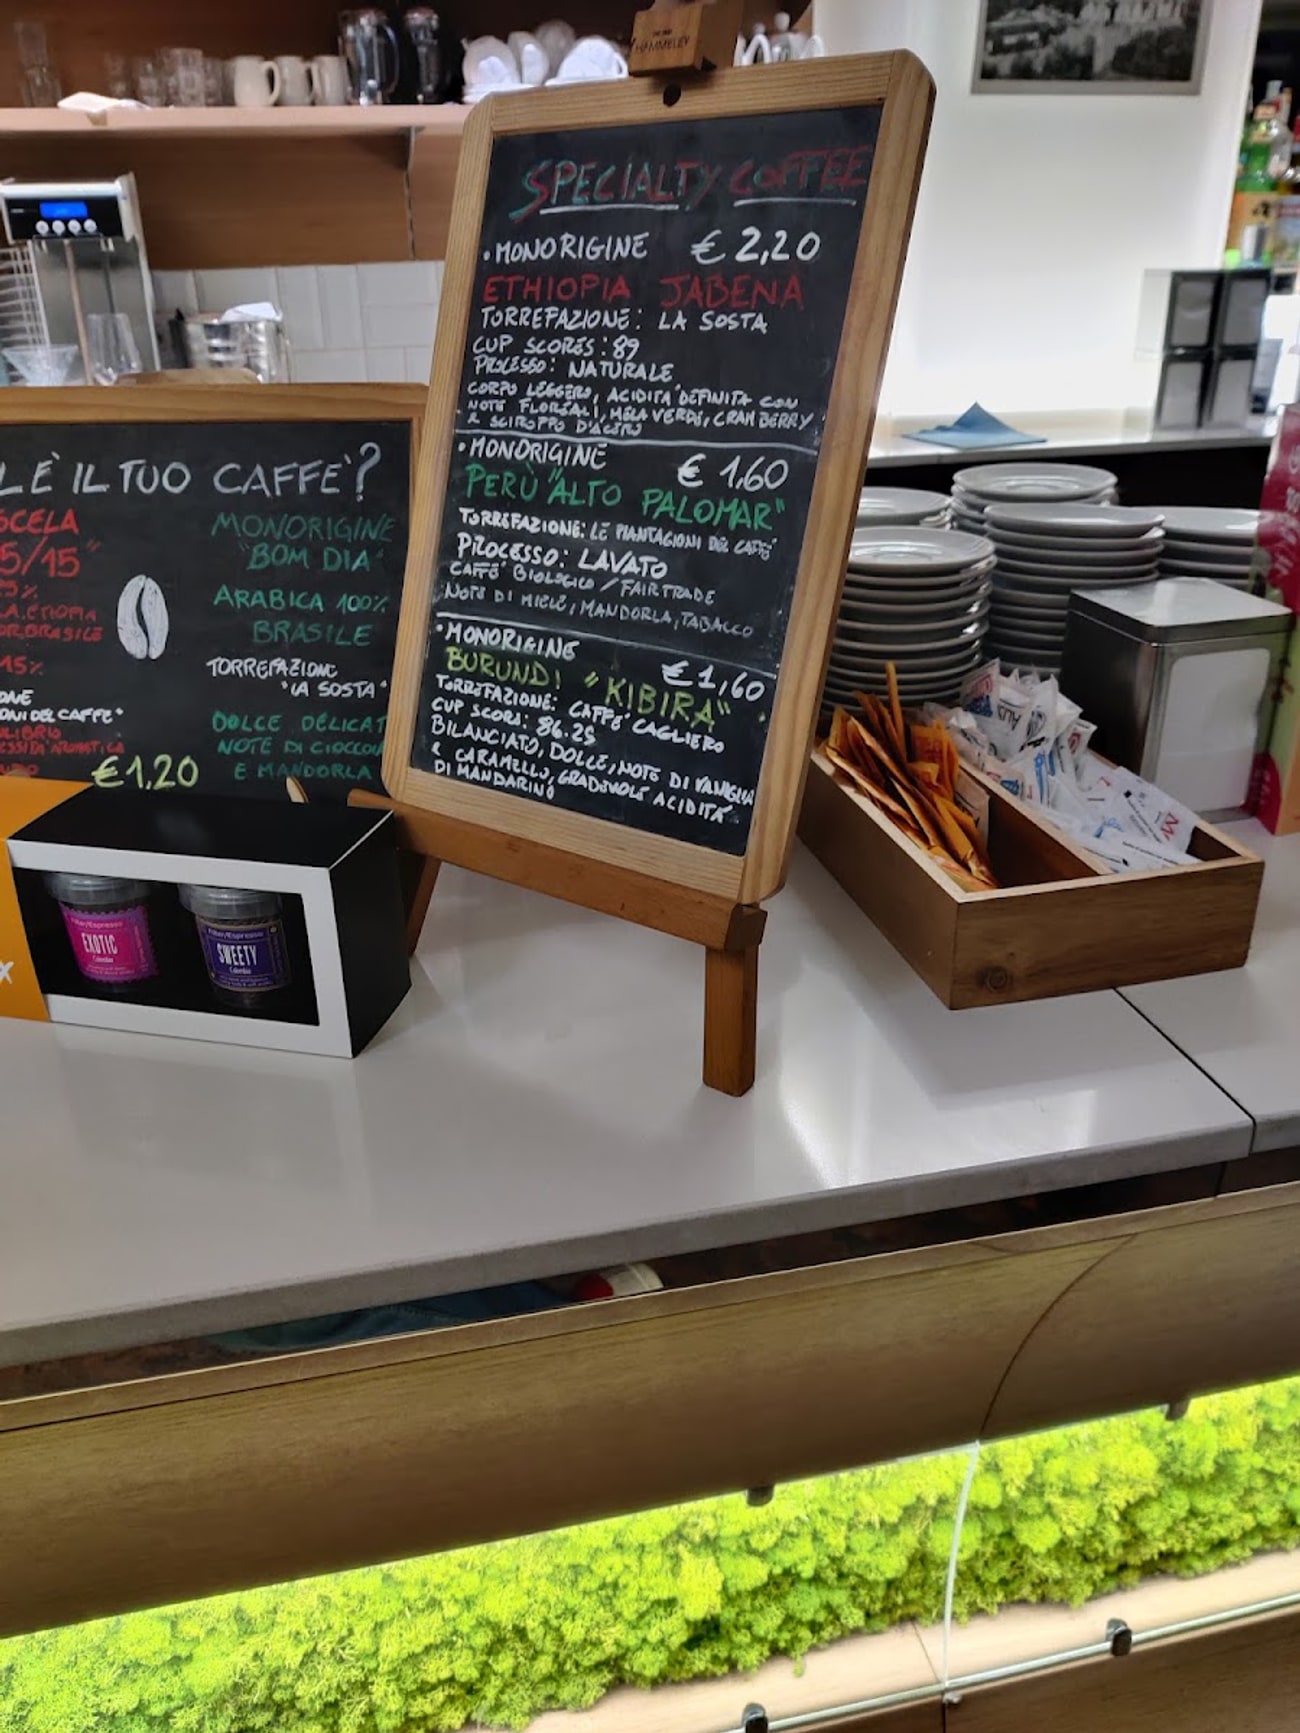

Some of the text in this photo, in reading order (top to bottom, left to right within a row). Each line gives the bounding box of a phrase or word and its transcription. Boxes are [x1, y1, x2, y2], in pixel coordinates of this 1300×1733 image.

[508, 145, 869, 223] SPECIALTY COFFEE
[735, 226, 821, 268] 2,20
[482, 274, 805, 311] ETHIOPIA JABENA
[481, 306, 767, 334] TORREFAZIONE: LA SOSTA
[472, 335, 514, 356] CUP
[568, 361, 674, 383] NATURALE
[467, 381, 518, 396] CORPO
[759, 396, 799, 410] CON
[467, 400, 506, 412] NOTE
[610, 406, 648, 422] MELA
[490, 416, 565, 432] SCIROPPO
[72, 462, 109, 494] IL
[119, 458, 191, 495] TUO
[470, 436, 607, 469] MONORIGINE
[719, 456, 790, 491] 1,60
[210, 512, 398, 544] MONORIGINE
[590, 522, 611, 541] LE
[616, 523, 702, 550] PIANTAGIONI
[708, 536, 729, 552] DEL
[513, 564, 594, 590] BIOLOGICO
[578, 548, 668, 579] LAVATO
[213, 584, 389, 614] ARABICA 100%
[445, 583, 486, 600] NOTE
[494, 590, 512, 603] DI
[681, 612, 754, 638] TABACCO
[252, 620, 374, 646] BRASILE
[445, 622, 581, 660] MONORIGINE
[206, 656, 338, 679] TORREFAZIONE
[30, 709, 56, 723] DEL
[431, 697, 464, 714] CUP
[536, 715, 596, 746] 86.25
[218, 737, 272, 755] NOTE
[284, 741, 303, 754] DI
[632, 718, 724, 753] CAGLIERO
[235, 762, 372, 780] E MANDORLA
[434, 760, 554, 799] DI MANDARINO
[617, 760, 661, 782] NOTE
[669, 772, 689, 790] DI
[81, 932, 118, 954] EXOTIC
[217, 943, 257, 966] SWEETY
